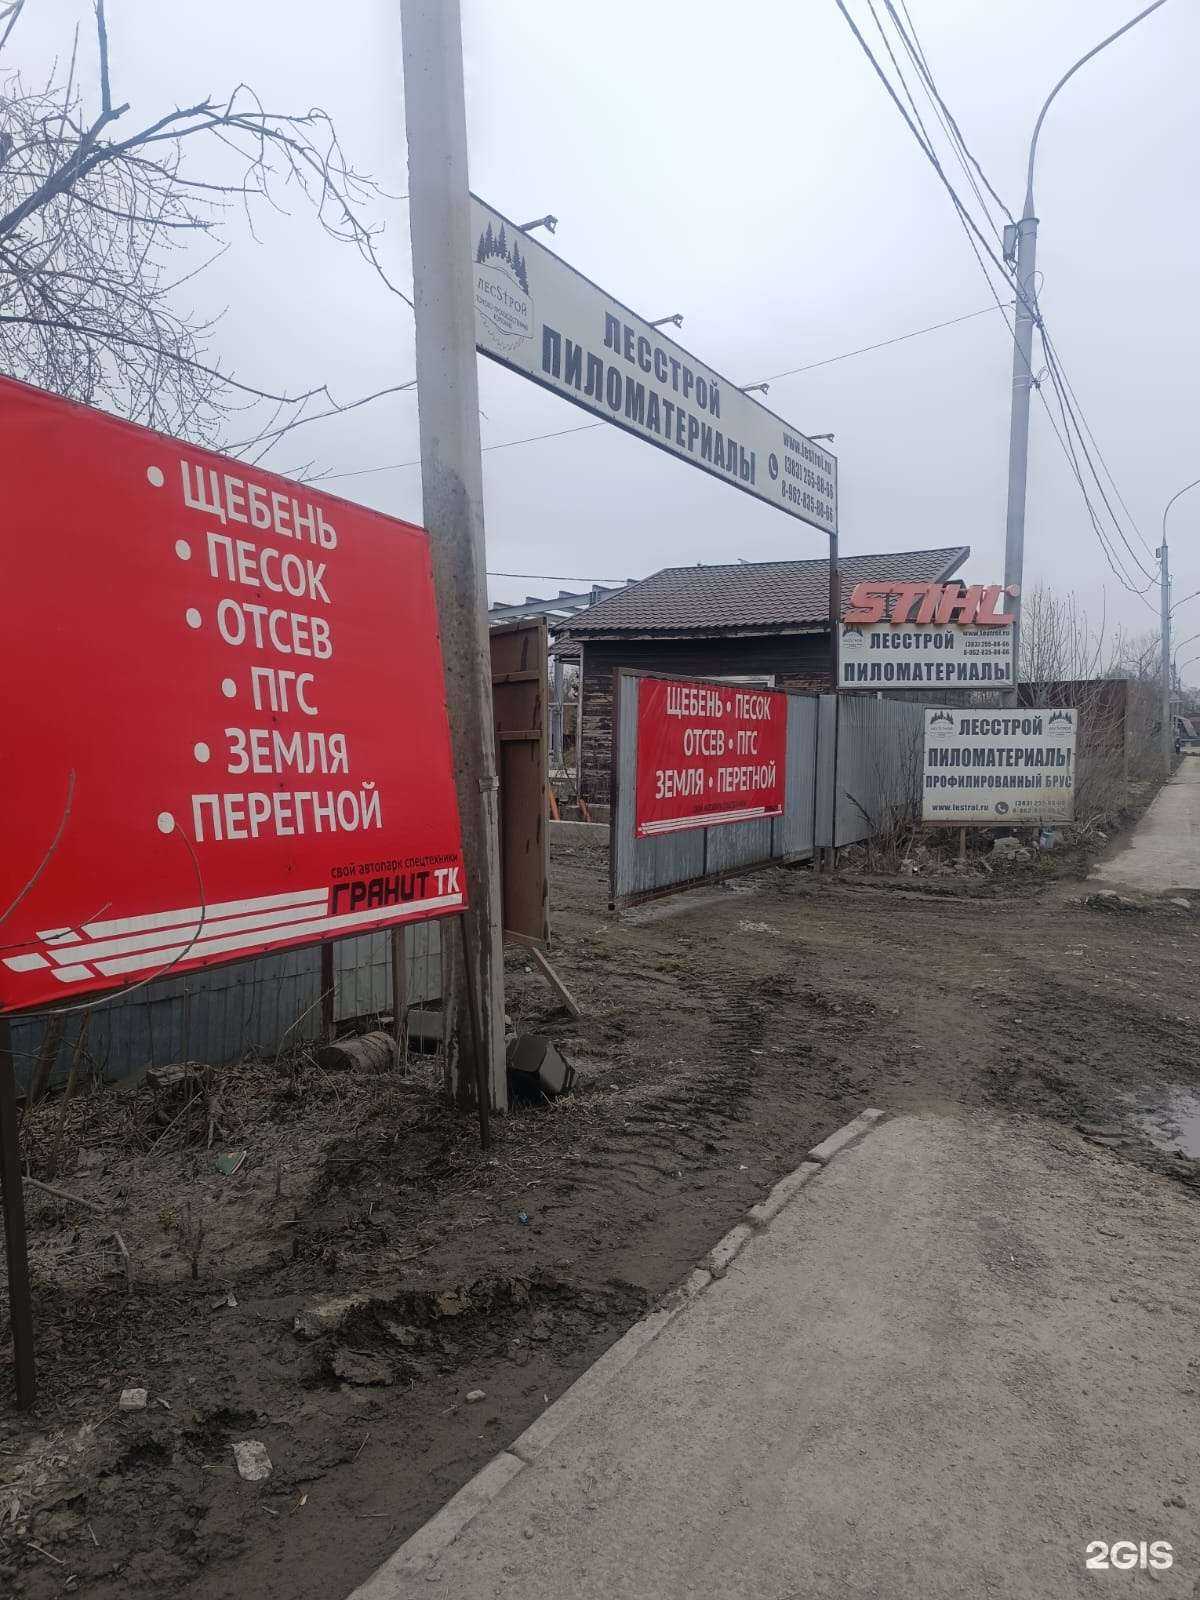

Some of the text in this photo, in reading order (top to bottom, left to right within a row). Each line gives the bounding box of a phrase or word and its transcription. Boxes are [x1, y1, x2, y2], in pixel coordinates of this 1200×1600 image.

[604, 312, 721, 419] ЛЕССТРОЙ
[542, 323, 756, 486] ПИЛОМАТЕРИАЛЫ
[180, 460, 338, 550] ЩЕБЕНЬ
[206, 532, 331, 604] ПЕСОК
[843, 582, 1016, 625] STIHL
[217, 598, 333, 660] ОТСЕВ
[869, 630, 955, 650] ЛЕССТРОЙ
[250, 666, 318, 715] ПГС
[843, 662, 1011, 682] ПИЛОМАТЕРИАЛЫ
[666, 686, 771, 720] ЩЕБЕНЬ ПЕСОК
[683, 729, 758, 756] ОТСЕВ ПГС
[958, 715, 1043, 736] ЛЕССТРОЙ
[226, 727, 350, 775] ЗЕМЛЯ
[927, 747, 1072, 767] ПИЛОМАТЕРИАЛЫ
[655, 760, 776, 799] ЗЕМЛЯ ПЕРЕГНОЙ
[925, 773, 1072, 788] ПРОФИЛИРОВАННЫЙ БРУС
[192, 780, 383, 842] ПЕРЕГНОЙ
[331, 854, 458, 879] свой автопарк спецтехники
[331, 867, 460, 915] ГРАНИТ ТК
